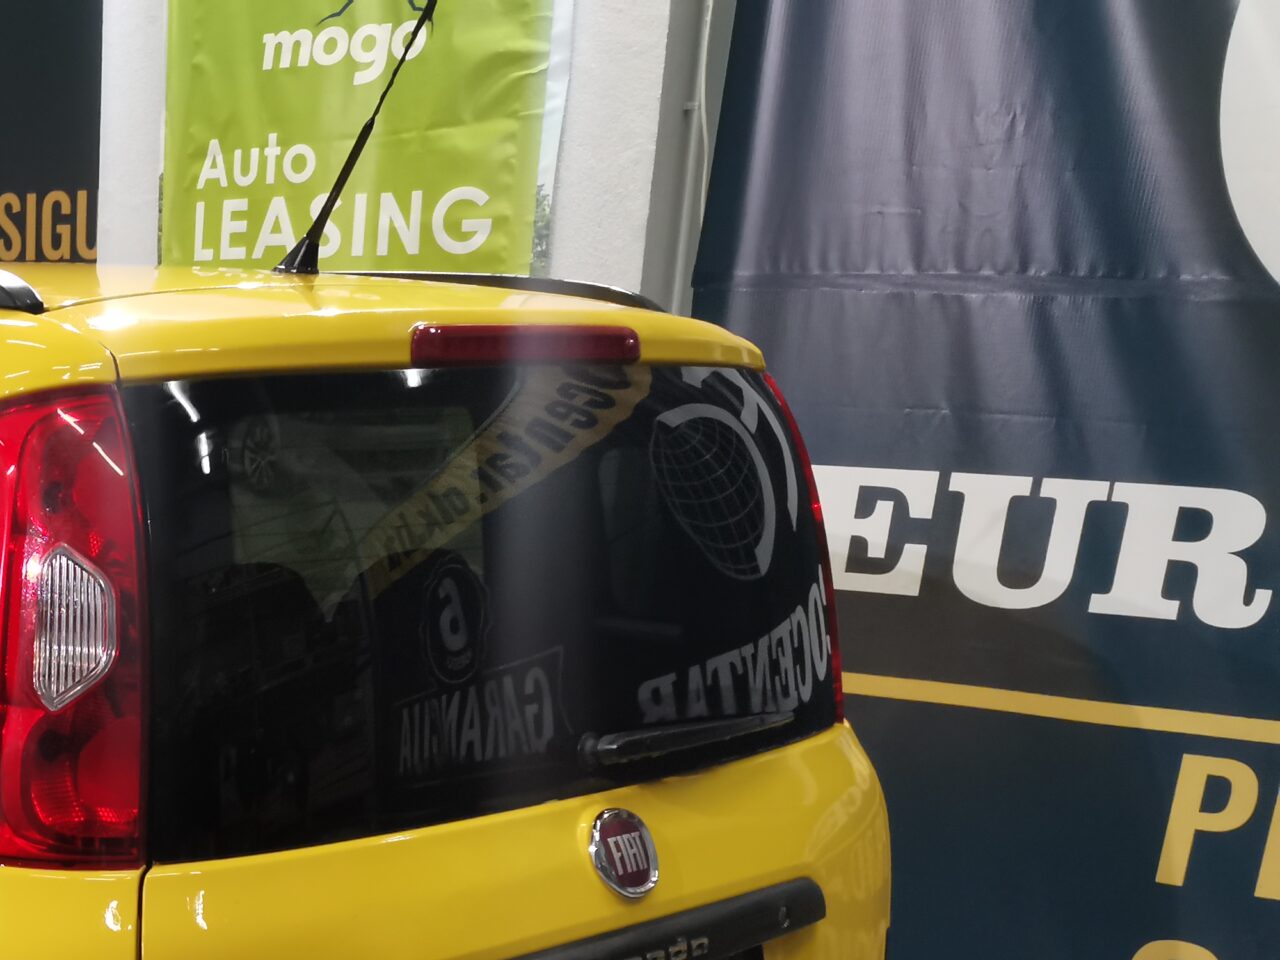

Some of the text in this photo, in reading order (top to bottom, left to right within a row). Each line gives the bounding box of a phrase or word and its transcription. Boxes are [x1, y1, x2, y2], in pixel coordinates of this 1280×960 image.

[262, 20, 427, 85] mogo
[196, 133, 316, 190] Auto
[193, 186, 493, 262] LEASING
[811, 464, 1273, 629] EUR
[607, 831, 649, 876] FIAT
